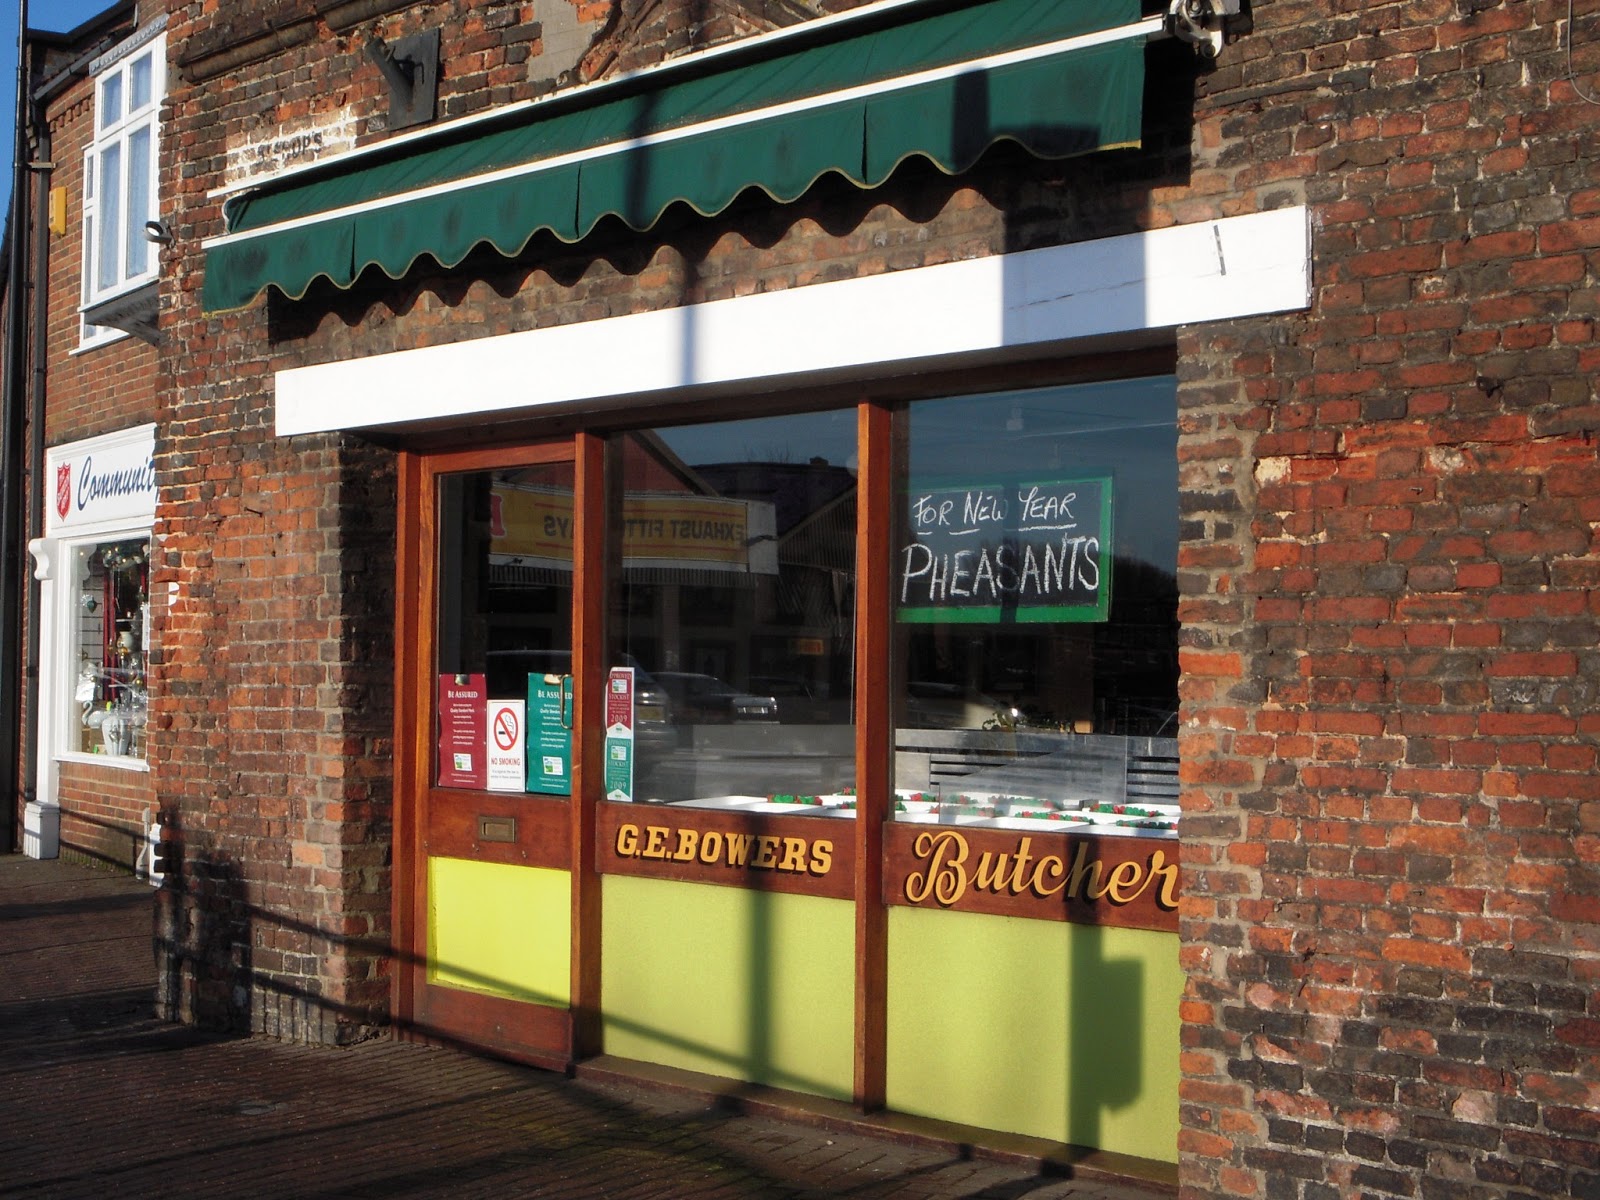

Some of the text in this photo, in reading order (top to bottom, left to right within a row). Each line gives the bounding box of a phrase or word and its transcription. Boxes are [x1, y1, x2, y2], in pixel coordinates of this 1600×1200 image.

[913, 494, 954, 527] FOR
[1018, 486, 1077, 522] YEAR
[901, 532, 1100, 603] PHEASANTS
[546, 691, 573, 700] ASSUED
[491, 757, 521, 766] NO SMOKING
